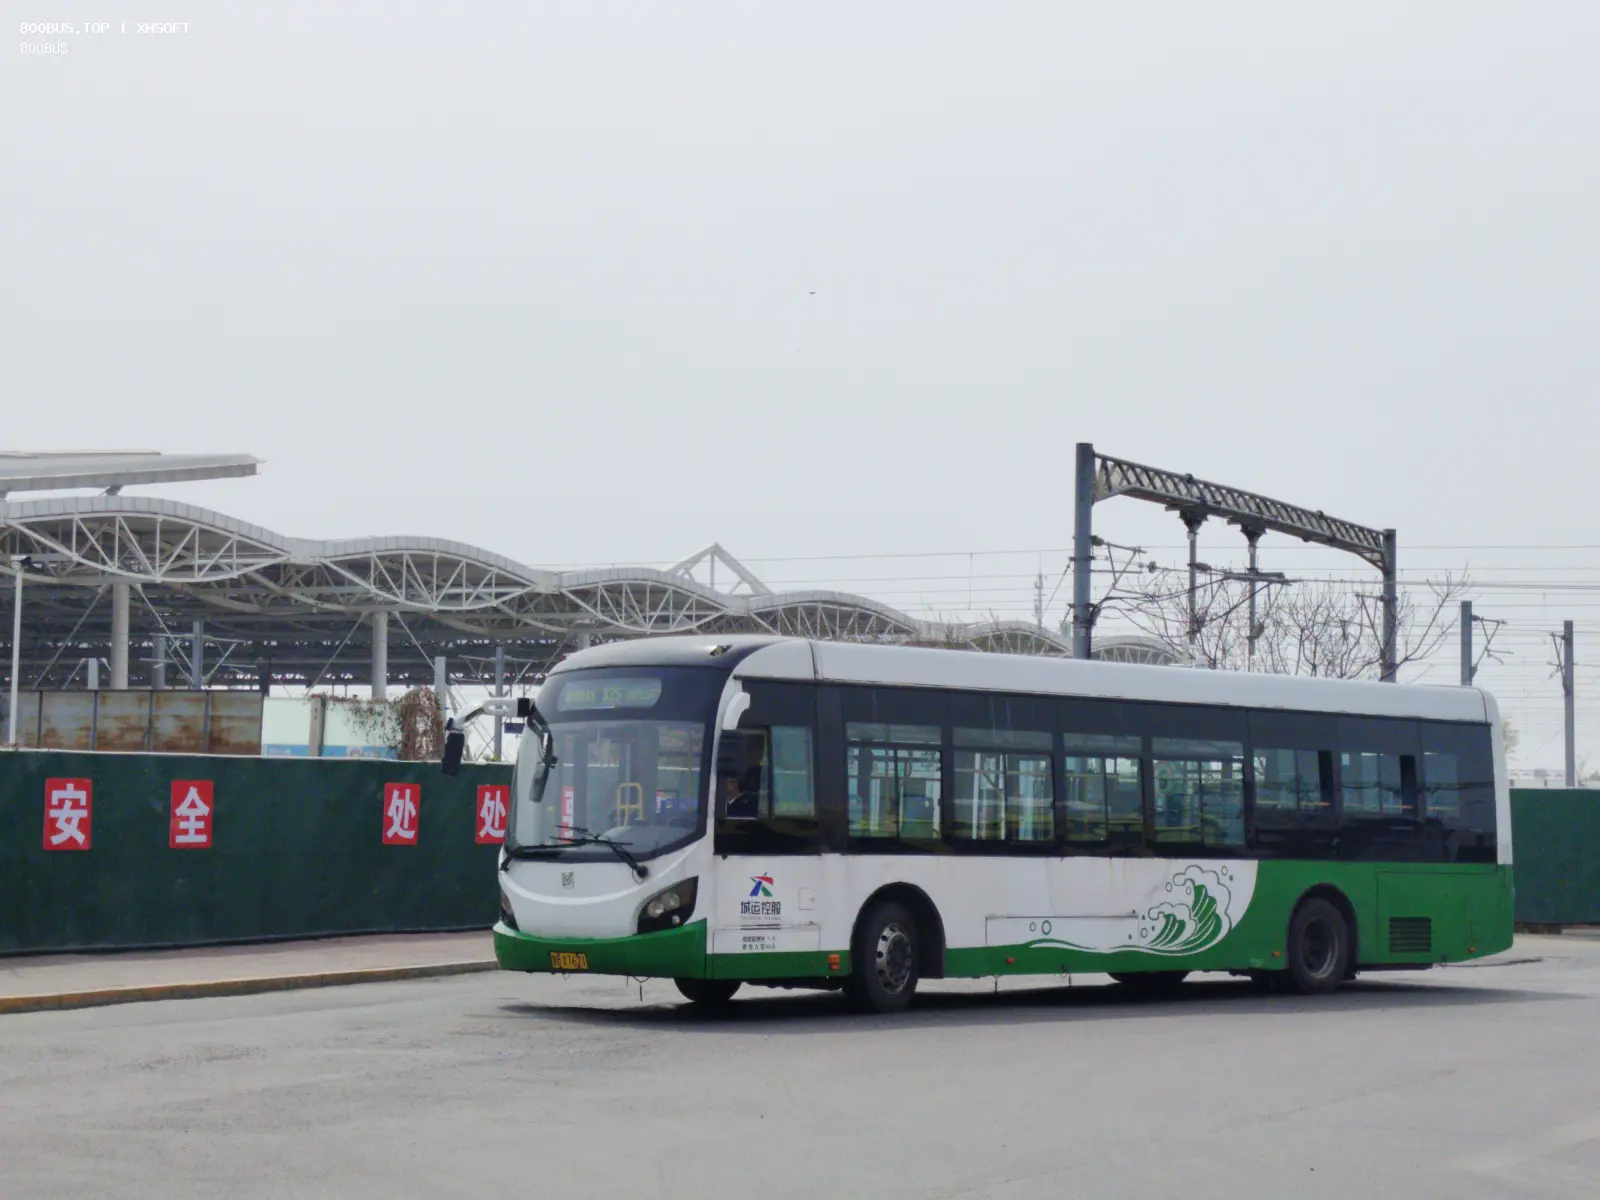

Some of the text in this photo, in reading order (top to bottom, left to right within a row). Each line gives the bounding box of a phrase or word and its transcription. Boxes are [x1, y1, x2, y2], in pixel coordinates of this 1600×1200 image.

[49, 783, 88, 845] 安
[174, 786, 211, 843] 全
[386, 788, 417, 840] 处
[478, 790, 506, 839] 处
[740, 900, 781, 916] 城运控股
